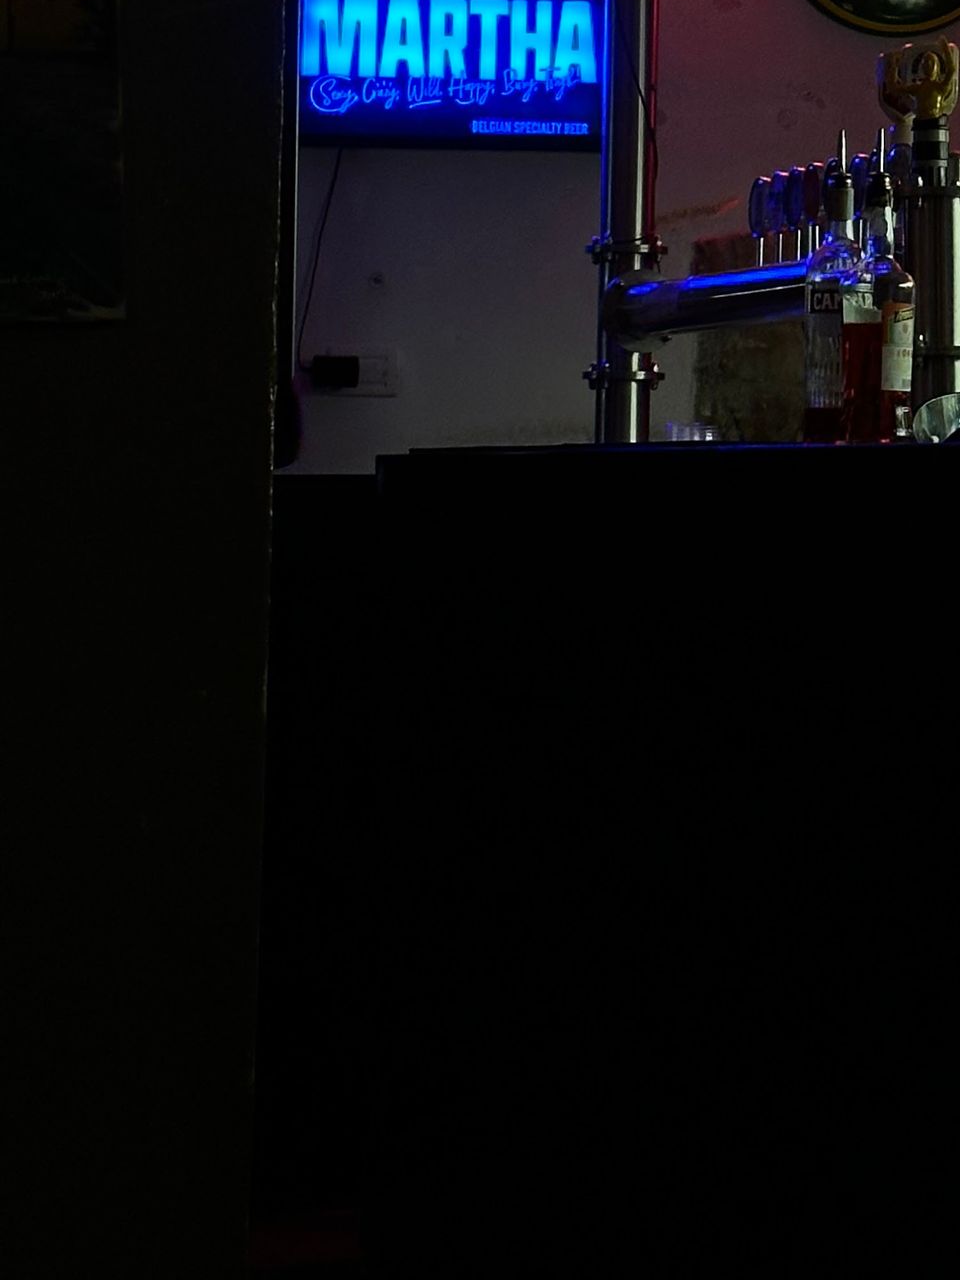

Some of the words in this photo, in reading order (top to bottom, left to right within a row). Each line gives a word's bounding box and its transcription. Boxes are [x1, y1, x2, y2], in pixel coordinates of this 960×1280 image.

[471, 119, 512, 134] BELGIAN
[513, 120, 562, 135] SPECIALTY
[564, 122, 590, 135] BEER
